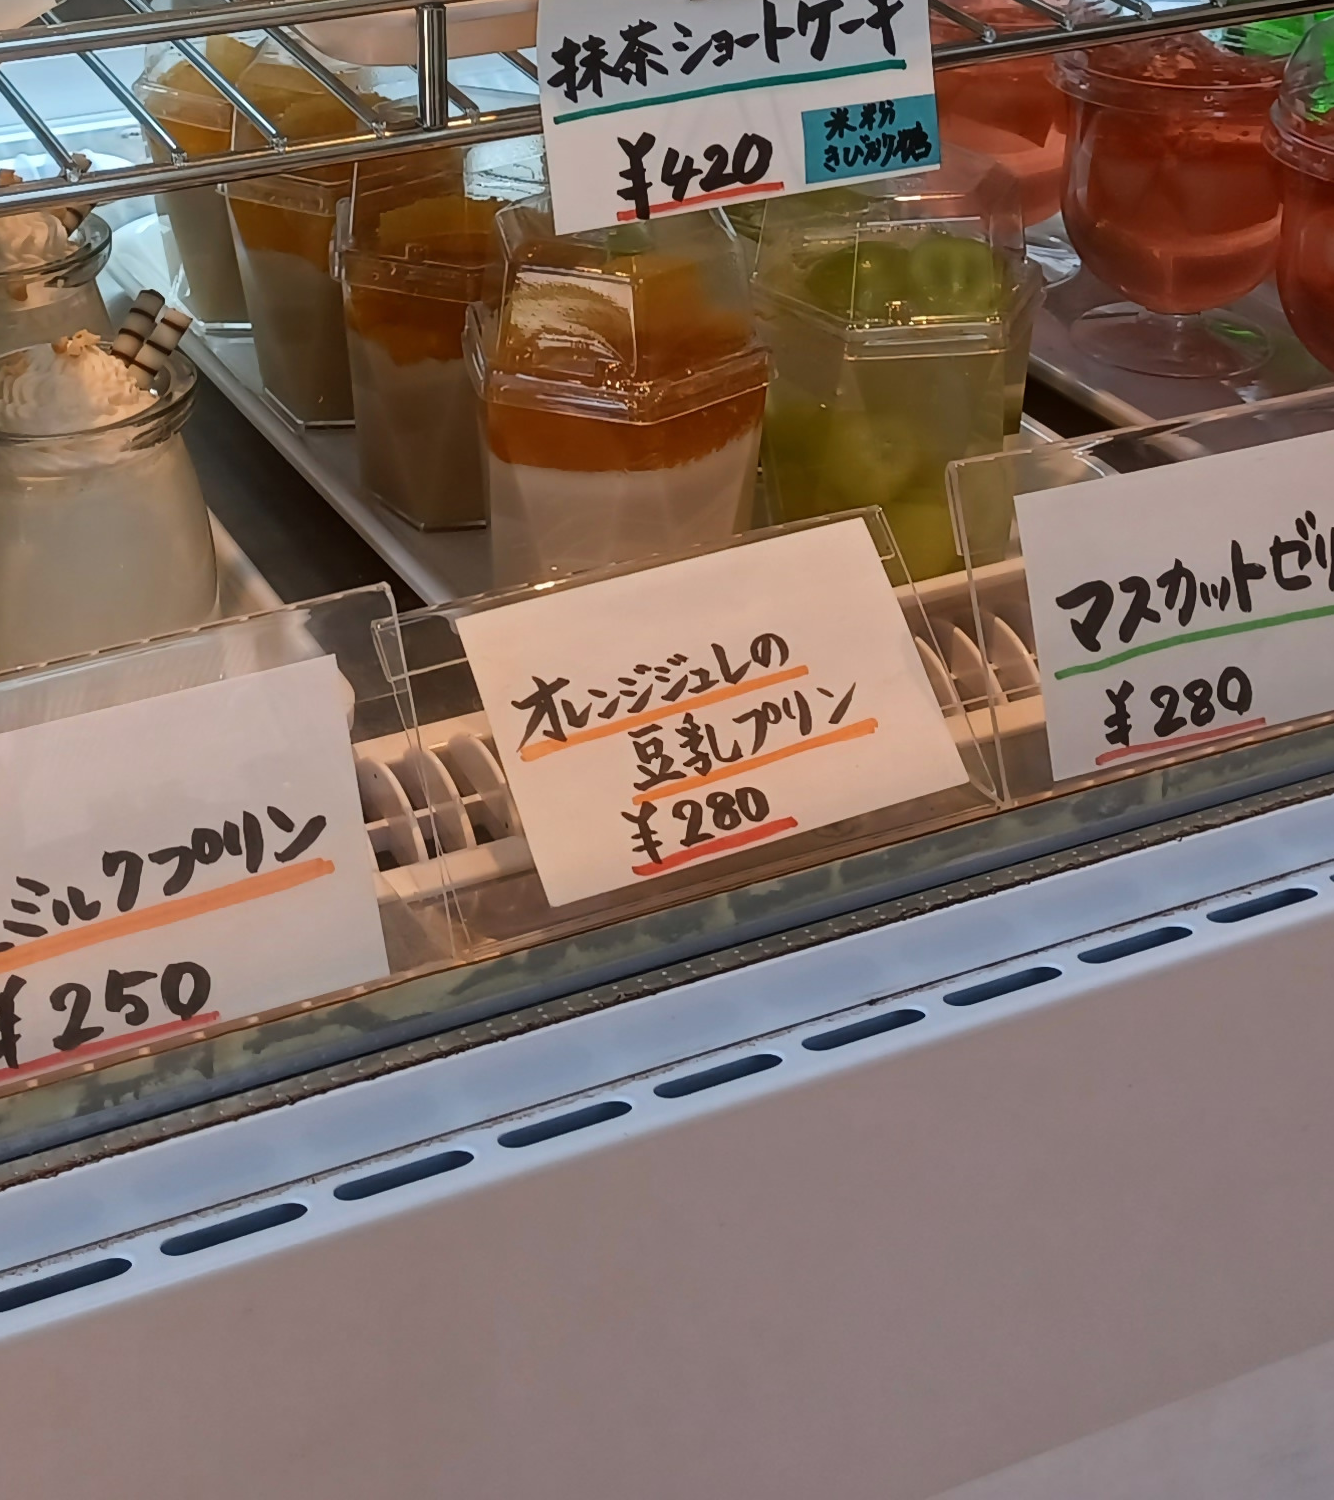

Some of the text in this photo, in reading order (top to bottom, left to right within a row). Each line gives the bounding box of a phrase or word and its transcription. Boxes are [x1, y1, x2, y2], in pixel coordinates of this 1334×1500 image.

[824, 100, 896, 140] 米粉
[616, 131, 773, 220] ¥420
[511, 632, 790, 752] オレンジジュレの
[1104, 666, 1254, 747] ¥280
[628, 682, 856, 791] 豆乳プリン
[621, 786, 770, 865] ¥280
